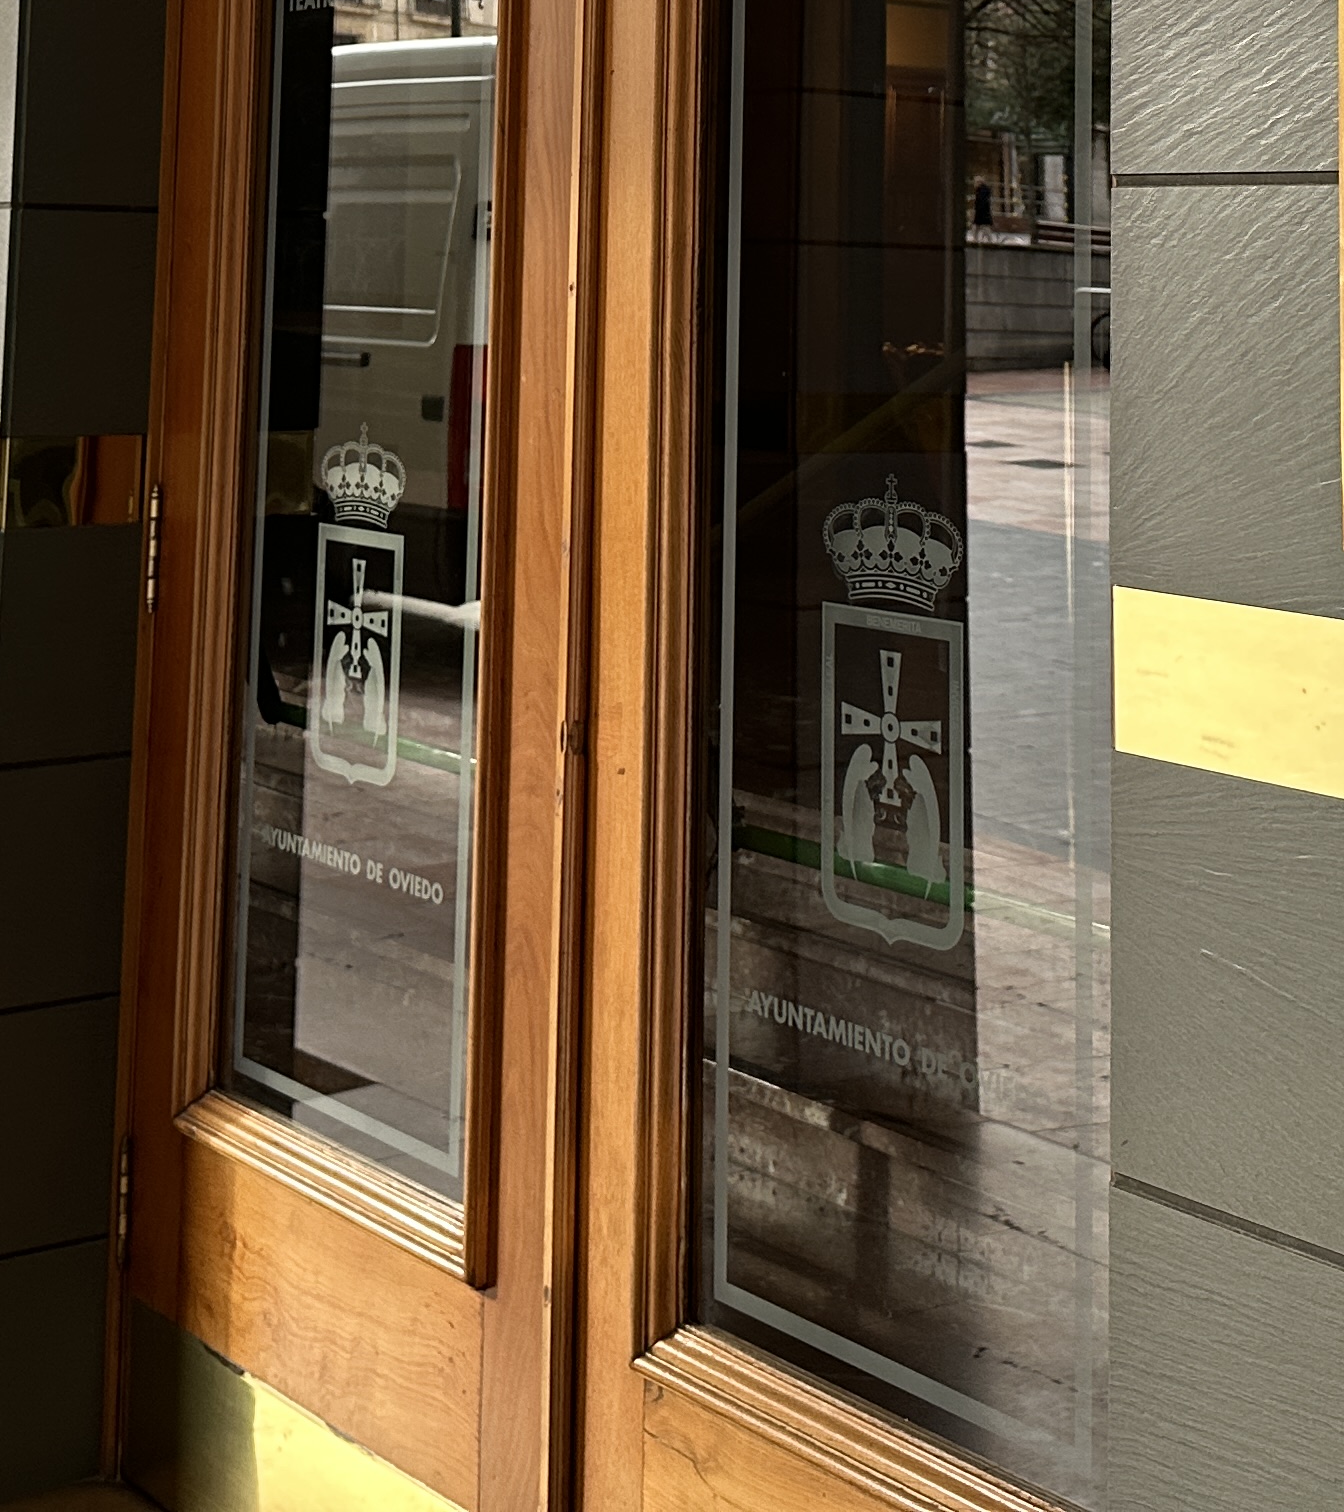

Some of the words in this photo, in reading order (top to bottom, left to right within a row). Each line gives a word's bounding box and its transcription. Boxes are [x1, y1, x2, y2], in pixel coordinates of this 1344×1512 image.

[262, 825, 362, 875] AYUNTAMIENTO
[366, 859, 384, 884] DE
[389, 867, 444, 905] OVIEDO
[748, 989, 912, 1067] AYUNTAMIENTO
[921, 1047, 949, 1080] DE
